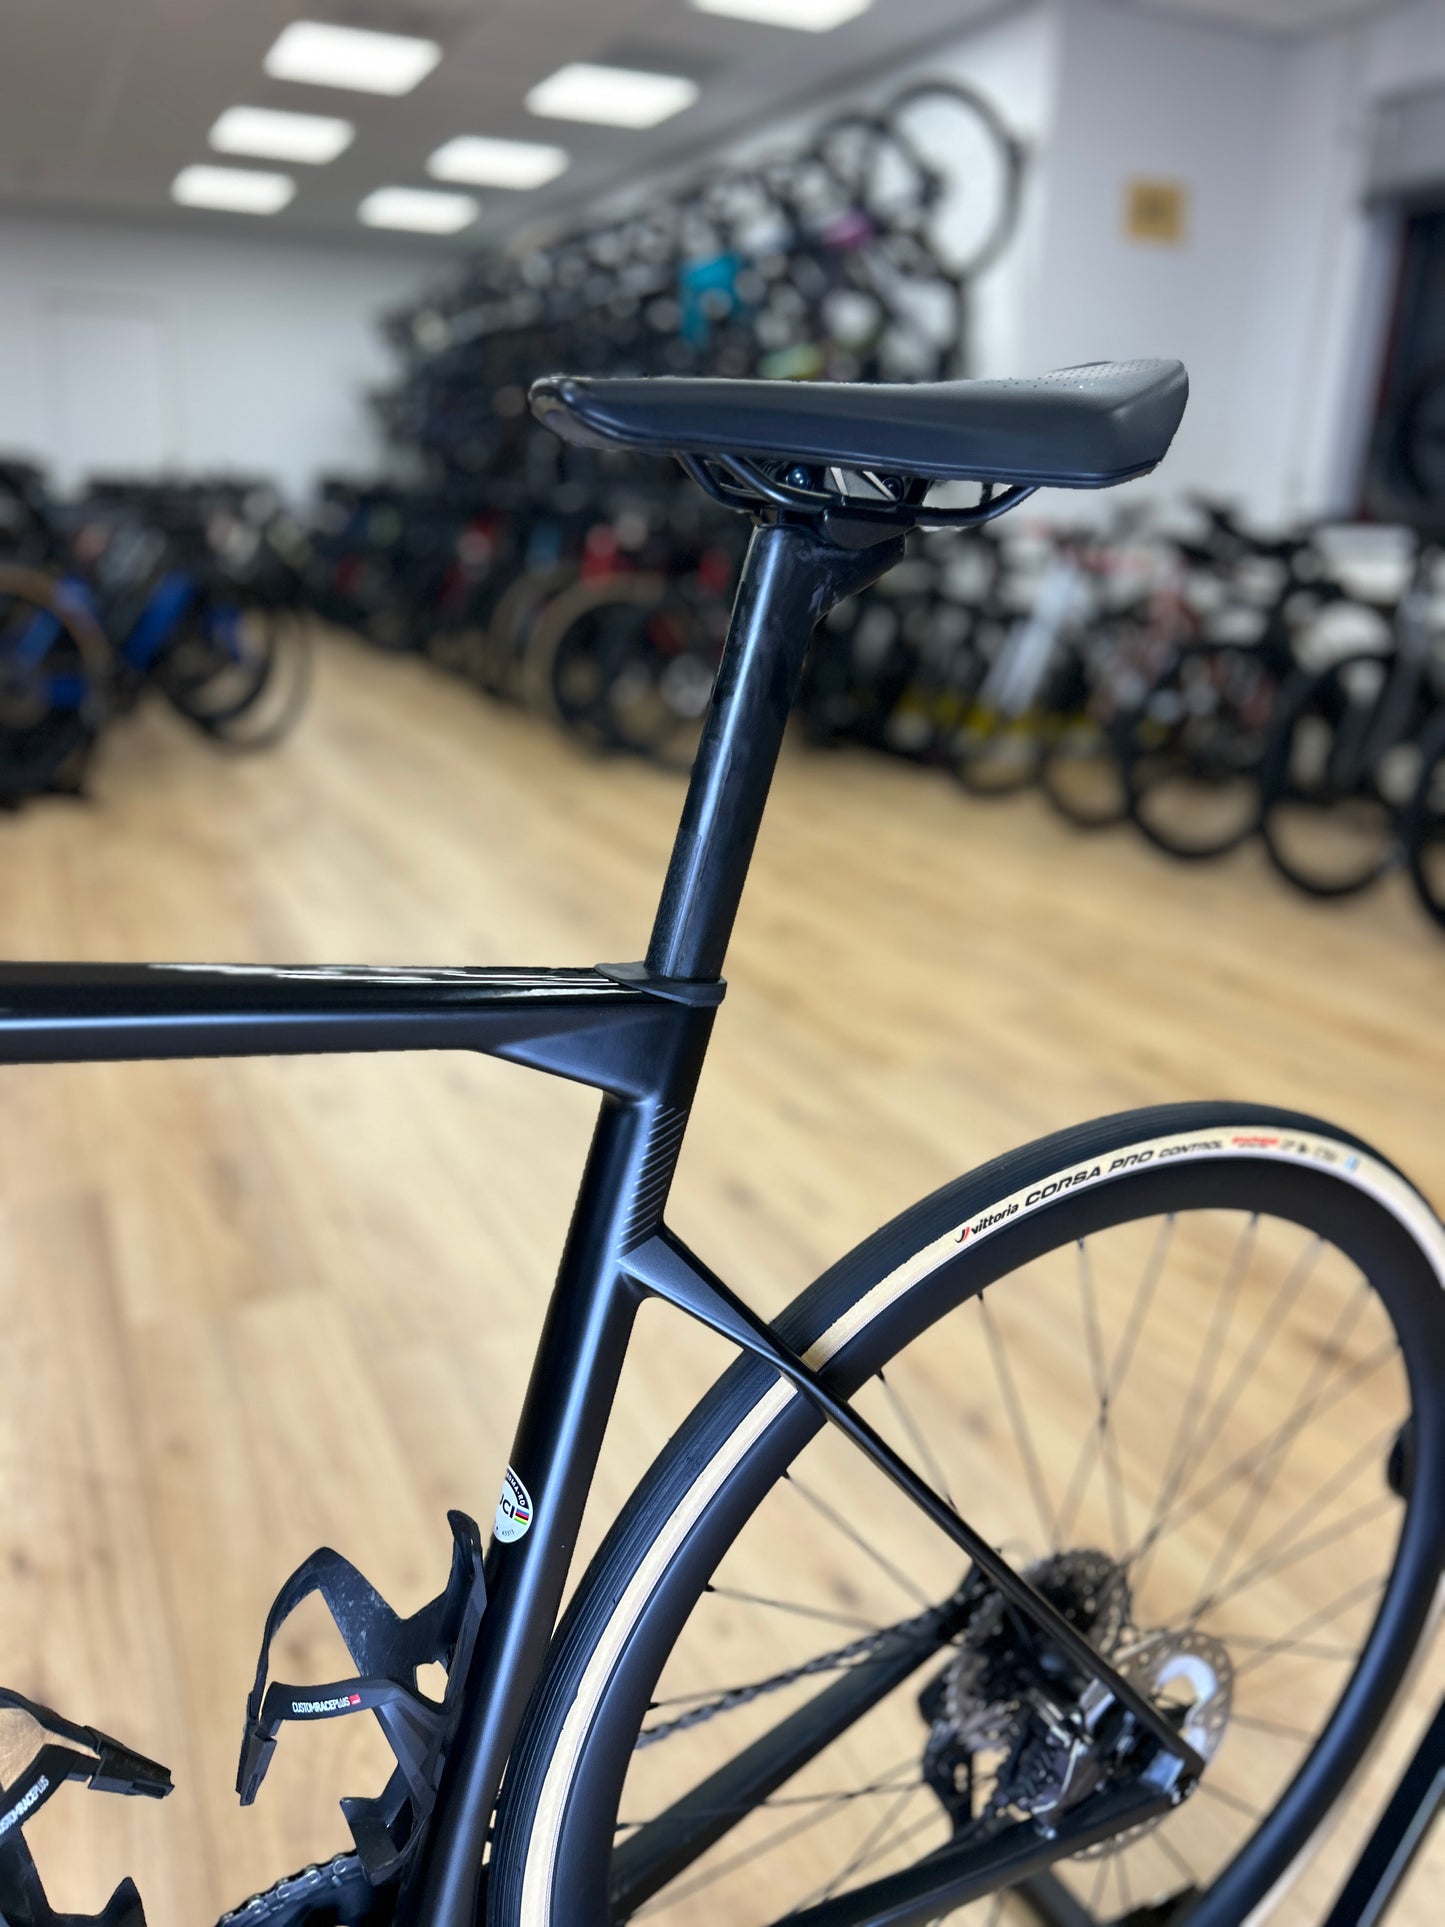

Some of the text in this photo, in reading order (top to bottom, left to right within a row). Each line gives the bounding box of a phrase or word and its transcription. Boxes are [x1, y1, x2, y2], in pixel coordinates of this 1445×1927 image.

[971, 1203, 1019, 1234] vittoria
[1025, 1166, 1101, 1207] CORSA
[1109, 1150, 1154, 1172] PRO
[1158, 1140, 1222, 1158] CONTROL
[291, 1696, 351, 1713] CUSTOMRACEPLUS
